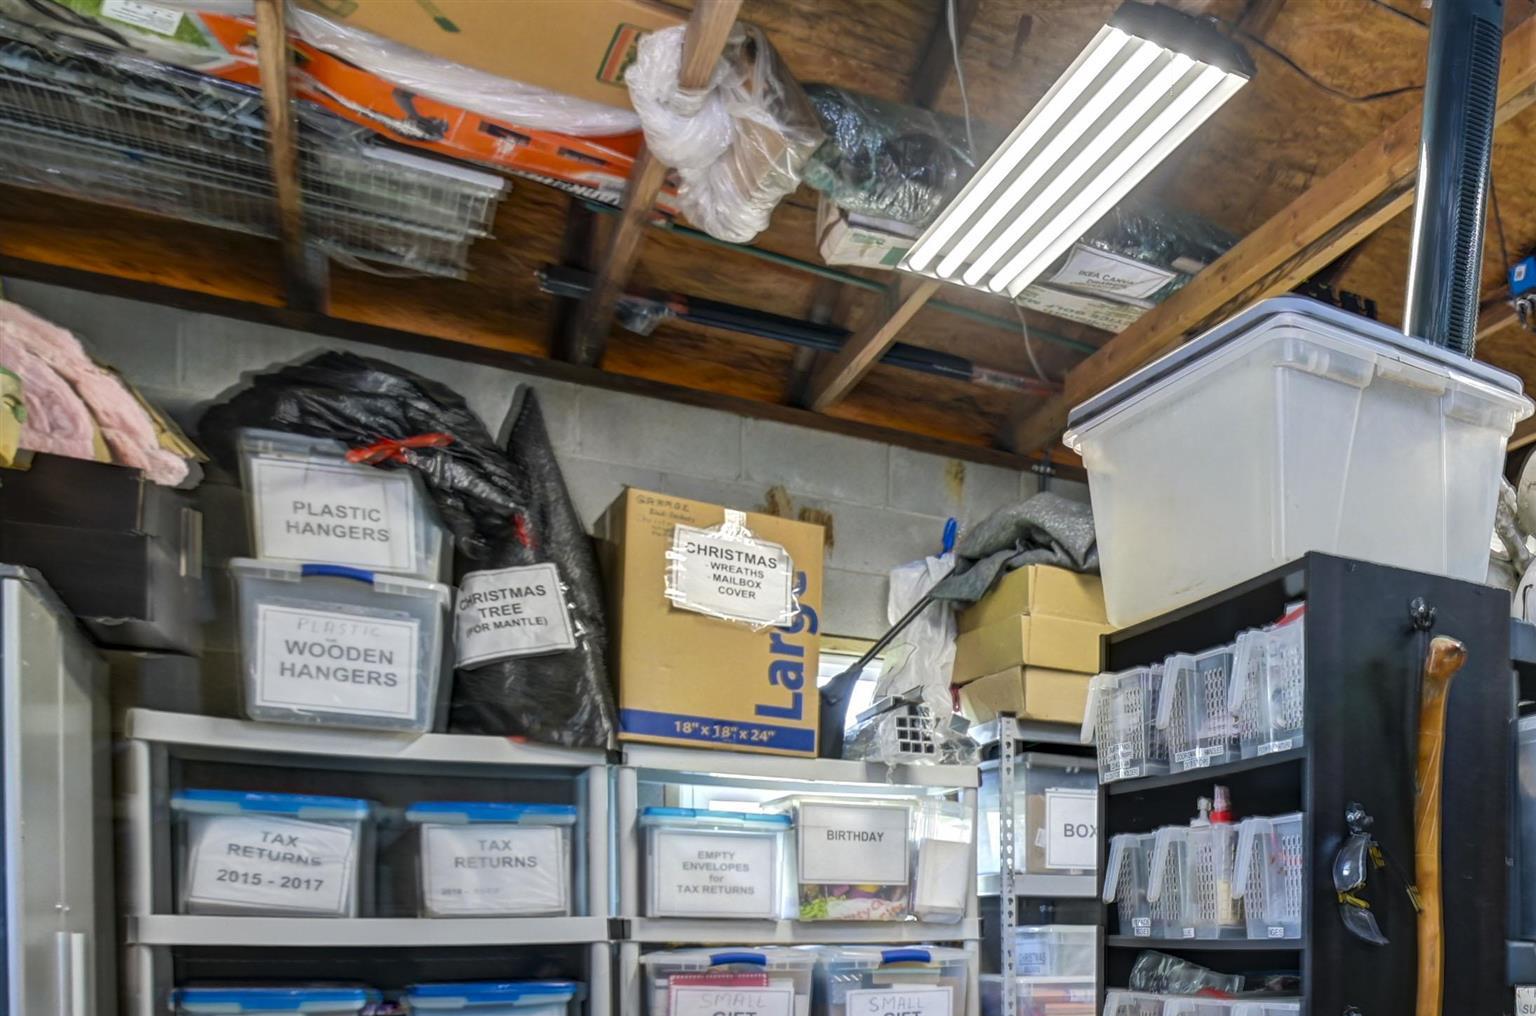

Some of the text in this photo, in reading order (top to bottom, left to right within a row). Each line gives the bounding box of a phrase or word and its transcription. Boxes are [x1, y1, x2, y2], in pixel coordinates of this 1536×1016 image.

[292, 500, 382, 523] PLASTIC
[285, 519, 390, 543] HANGERS
[686, 541, 778, 570] CHRISTMAS
[459, 584, 547, 611] CHRISTMAS
[718, 586, 757, 600] COVER
[478, 603, 523, 619] TREE
[493, 616, 549, 632] MANTLE)
[284, 639, 394, 666] WOODEN
[279, 661, 398, 687] HANGERS
[674, 720, 700, 735] 18"
[712, 723, 738, 739] 18"
[750, 728, 776, 743] 24"
[260, 830, 300, 848] TAX
[826, 829, 885, 843] BIRTHDAY
[477, 839, 513, 852] TAX
[227, 843, 323, 868] RETURNS
[454, 855, 538, 870] RETURNS
[697, 850, 735, 862] EMPTY
[682, 861, 750, 873] ENVELOPES
[216, 868, 263, 887] 2015
[280, 875, 324, 892] 2017
[709, 873, 724, 883] for
[677, 884, 755, 896] TAX RETURNS
